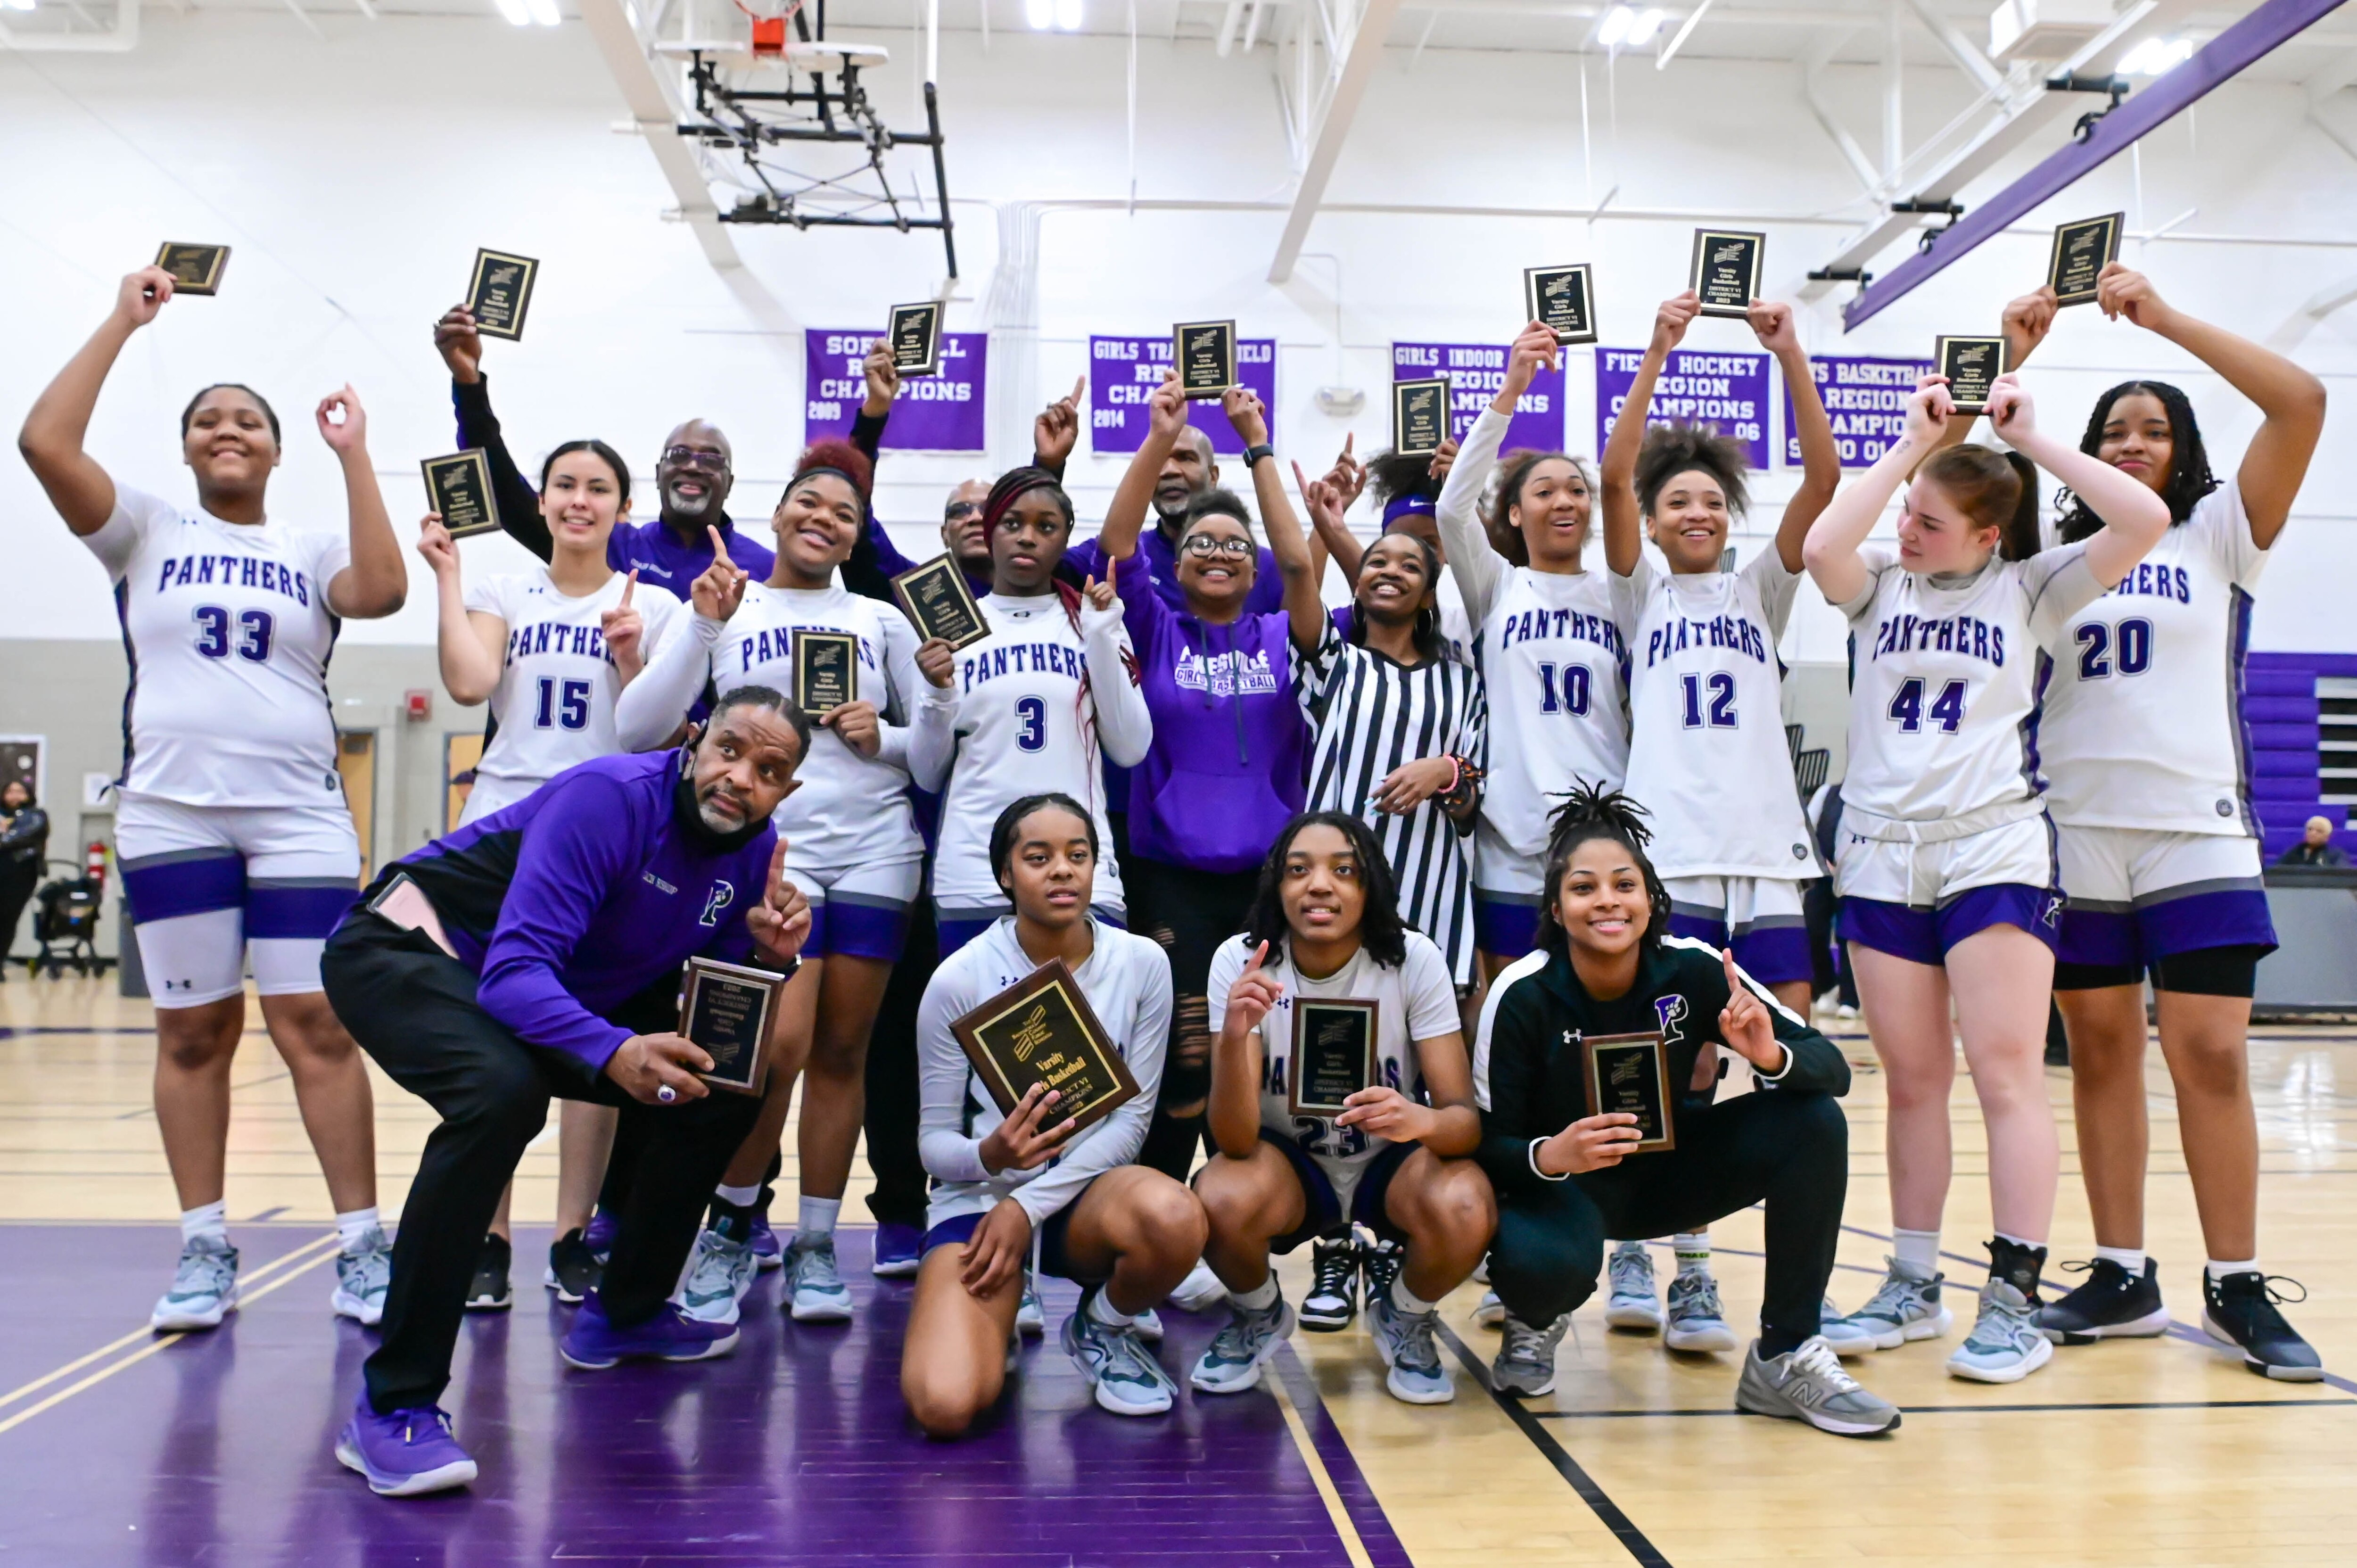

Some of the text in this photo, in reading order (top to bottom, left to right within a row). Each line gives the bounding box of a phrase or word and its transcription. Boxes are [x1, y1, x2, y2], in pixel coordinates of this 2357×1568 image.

[1094, 341, 1139, 360] GIRLS
[1395, 347, 1503, 368] GIRLS INDOOR
[1678, 355, 1760, 377] HOCKEY
[821, 379, 972, 401] CHAPIONS
[1611, 396, 1755, 419] CAMPIONS
[1653, 377, 1730, 397] EGION
[1093, 409, 1125, 428] 2014
[158, 555, 309, 608] PANTHERS
[192, 602, 276, 663] 33
[1503, 608, 1624, 664] PANTHERS
[1648, 614, 1765, 668] PANTHERS
[1872, 614, 2004, 668] PANTHERS
[2075, 616, 2154, 681] 20
[534, 675, 593, 732] 15
[1538, 661, 1592, 718] 10
[1680, 670, 1738, 729] 12
[1887, 677, 1968, 735] 44
[1015, 694, 1047, 753] 3
[699, 879, 734, 927] P
[1655, 994, 1689, 1045] P
[1036, 1051, 1064, 1071] Varsity
[1047, 1056, 1086, 1086] Basketball
[1293, 1115, 1369, 1158] 23
